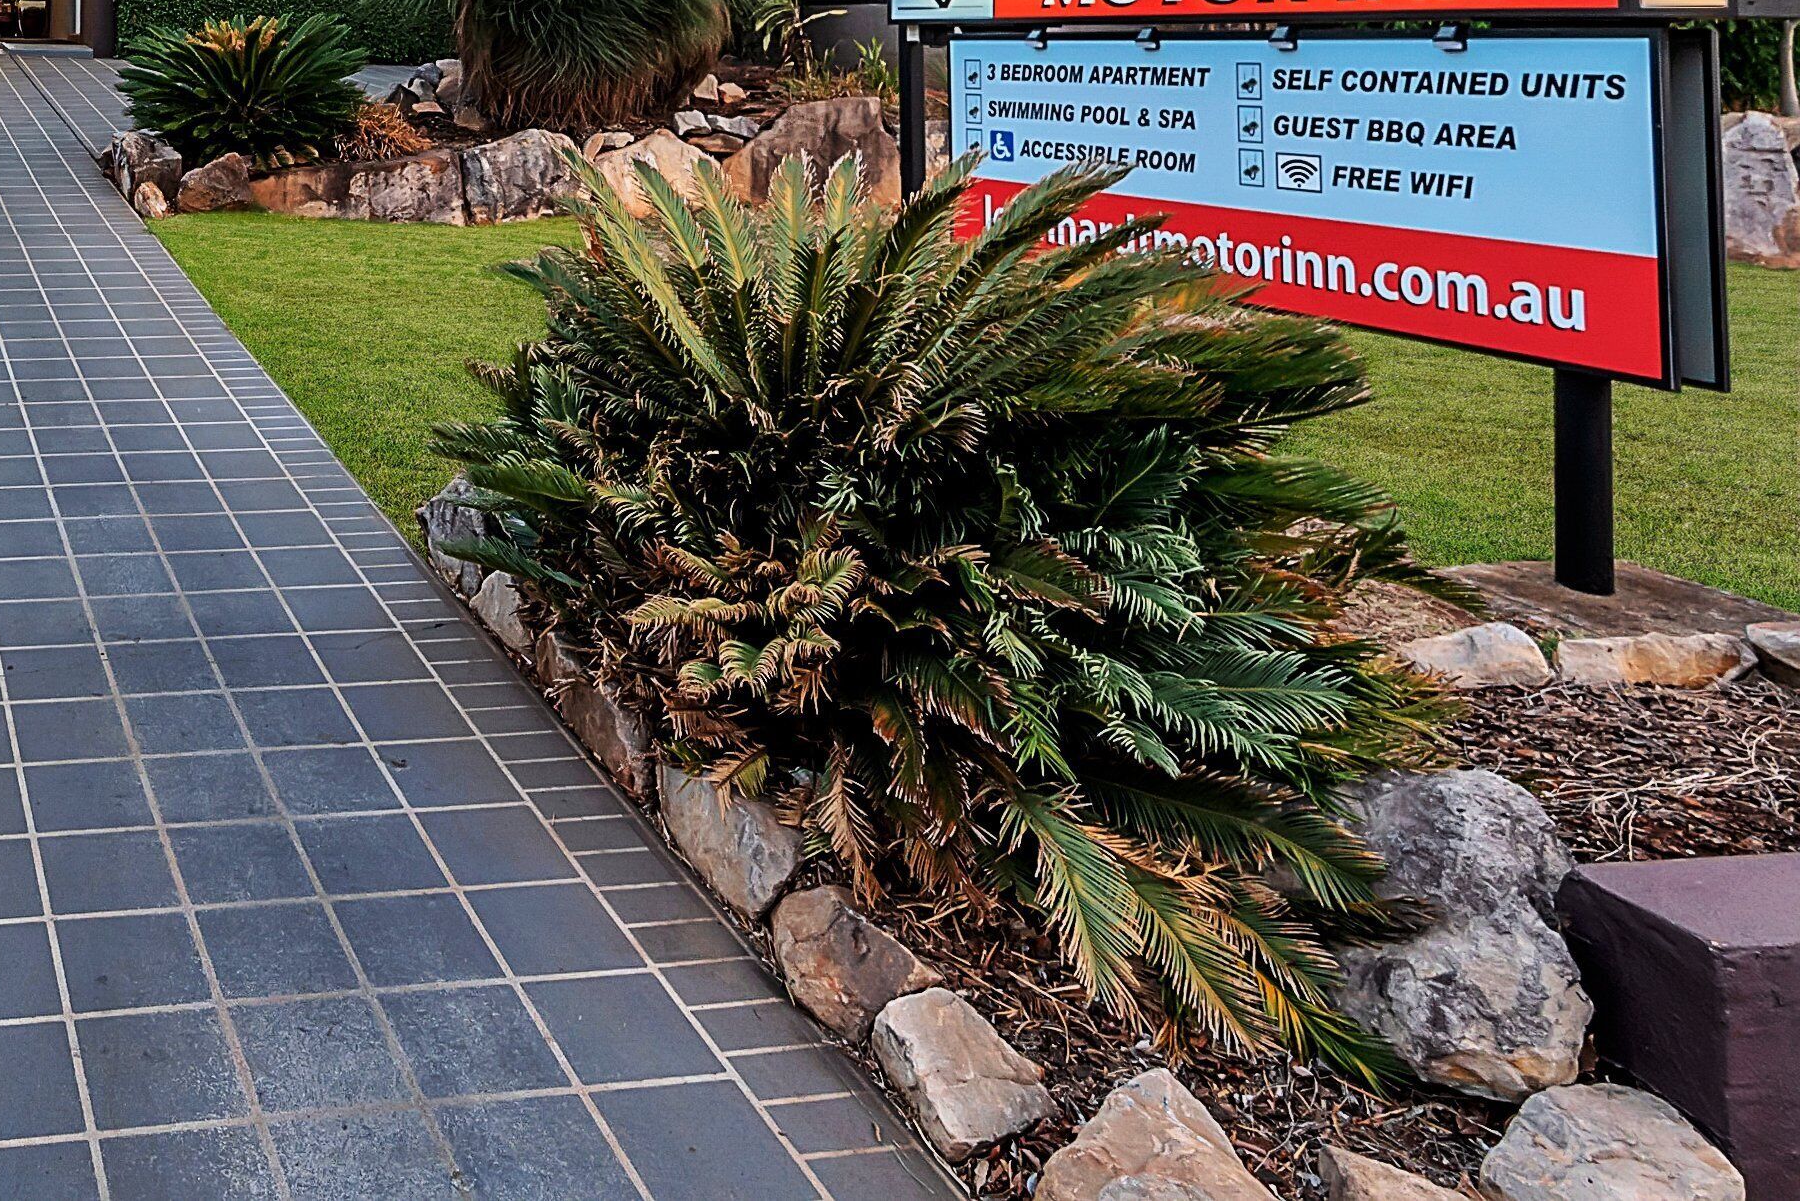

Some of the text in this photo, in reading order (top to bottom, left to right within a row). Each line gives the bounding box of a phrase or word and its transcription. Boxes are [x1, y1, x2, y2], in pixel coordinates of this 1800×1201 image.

[986, 63, 1211, 87] 3 BEDROOM APARTMENT
[1272, 68, 1628, 100] SELF CONTAINED UNITS
[987, 100, 1197, 131] SWIMMING POOL & SPA
[1273, 115, 1518, 151] GUEST BBQ AREA
[1019, 138, 1197, 174] ACCESSIBLE ROOM
[1332, 165, 1475, 200] FREE WIFI
